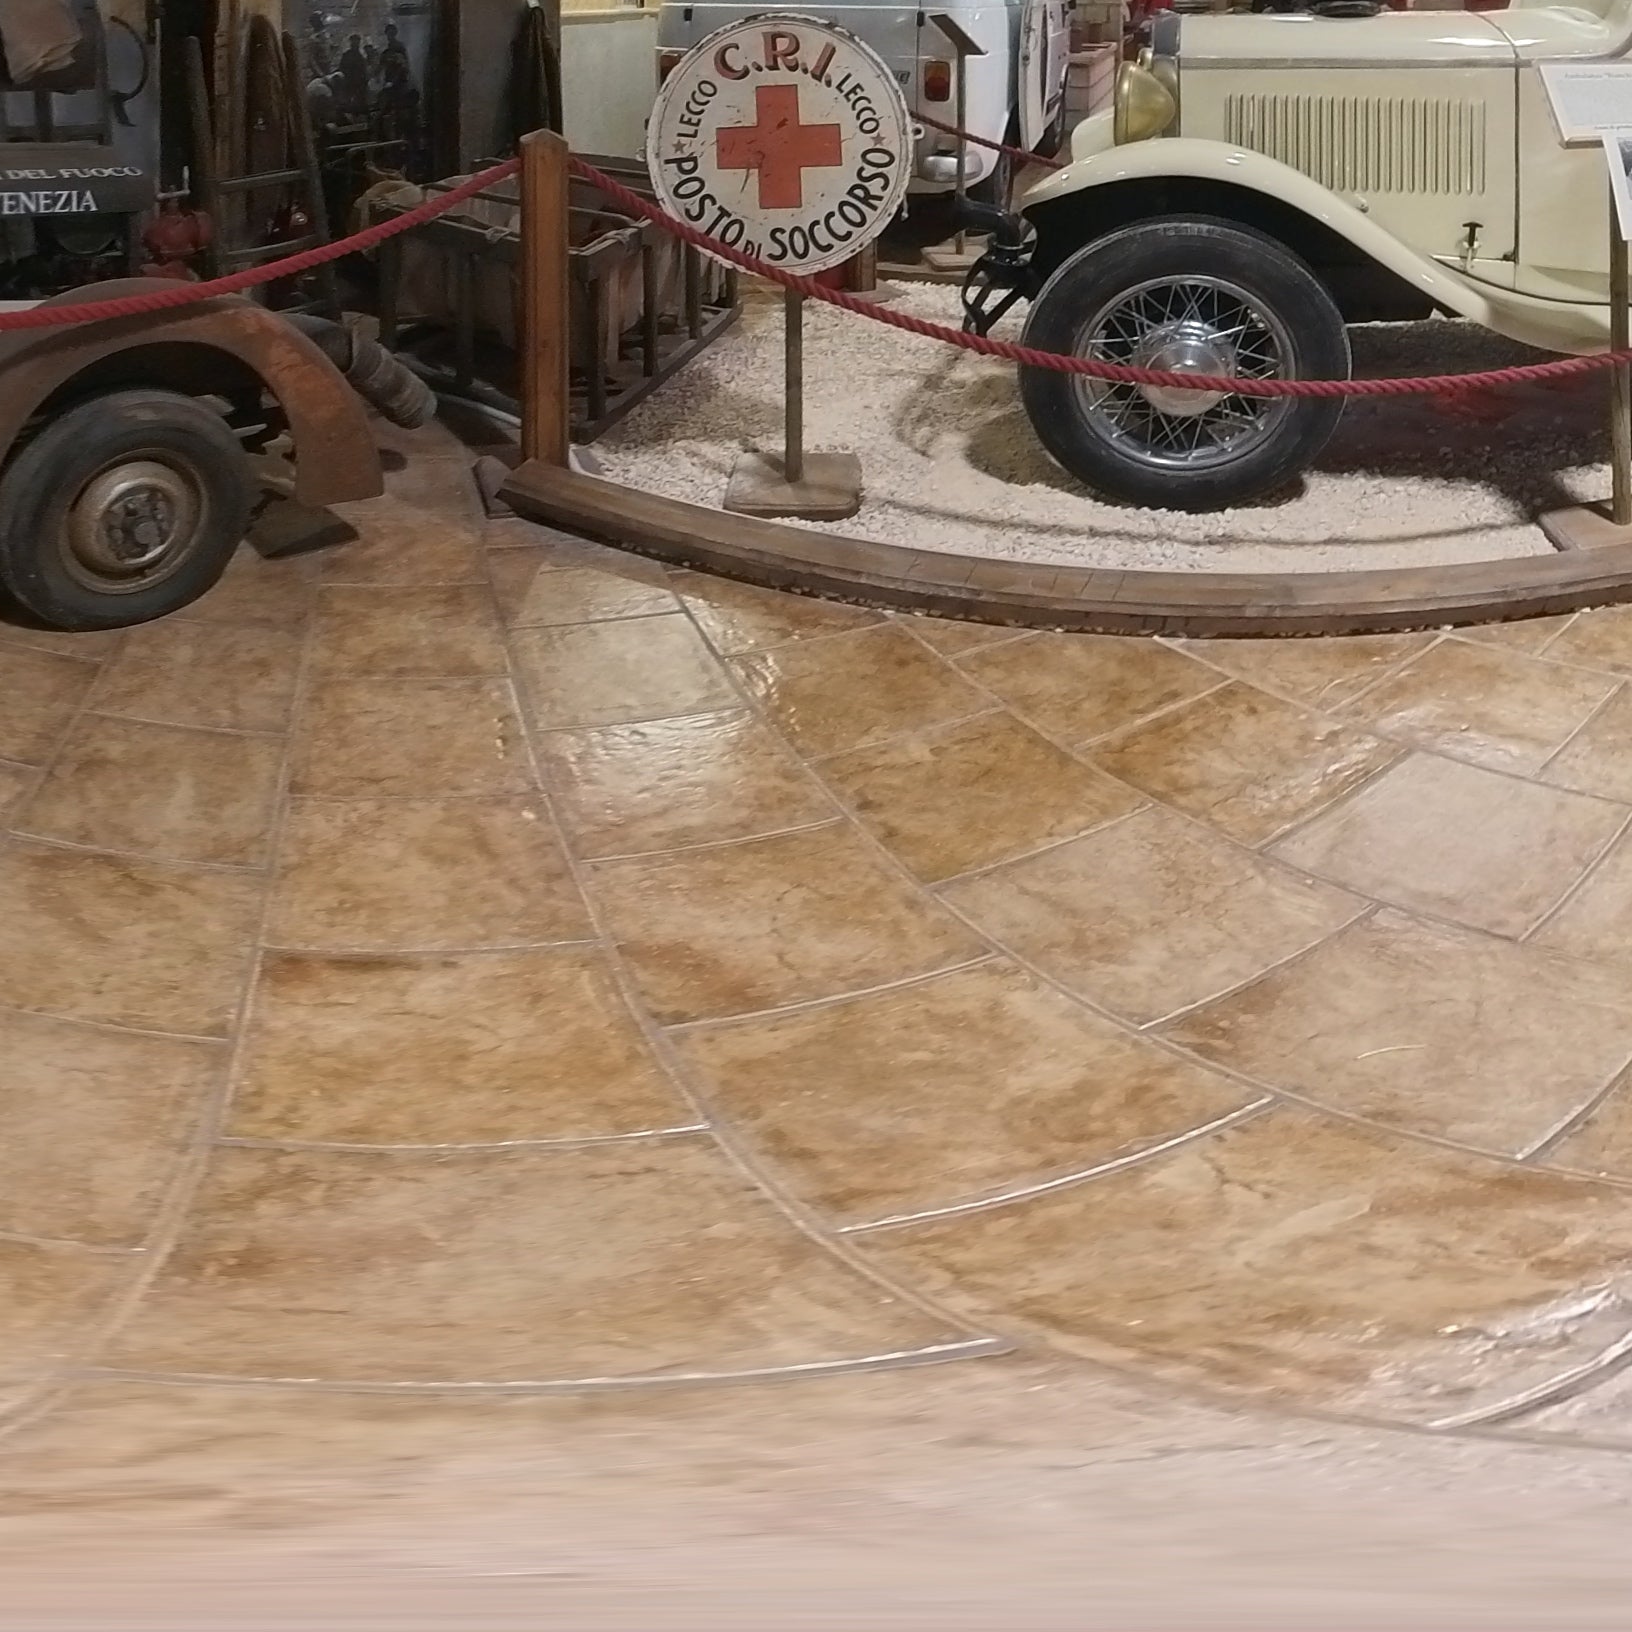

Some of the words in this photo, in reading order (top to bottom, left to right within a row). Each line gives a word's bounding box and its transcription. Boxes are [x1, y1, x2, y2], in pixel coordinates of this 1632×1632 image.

[713, 30, 836, 88] C.R.I.
[677, 80, 718, 139] LECCO
[835, 73, 880, 135] LECCO
[7, 168, 57, 179] DEL
[59, 166, 144, 178] FUOCO
[664, 155, 745, 248] POSTO
[767, 147, 896, 261] SOCCORSO
